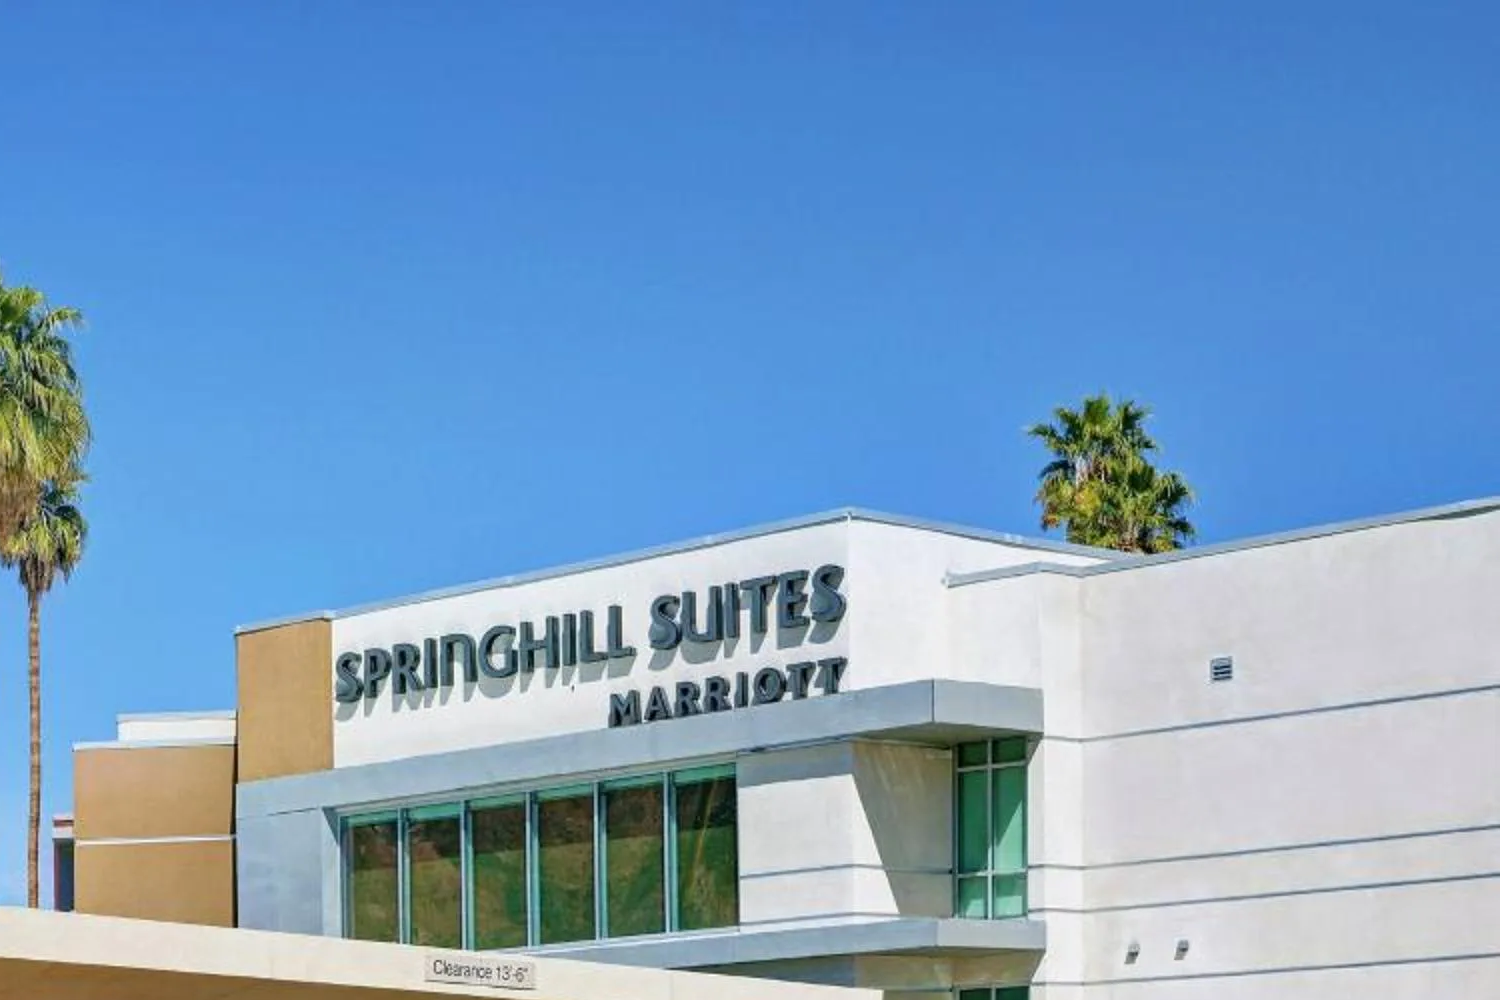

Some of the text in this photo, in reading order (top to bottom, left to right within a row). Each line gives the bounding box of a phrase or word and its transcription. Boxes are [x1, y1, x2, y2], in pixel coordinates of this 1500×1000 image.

[336, 564, 847, 703] SPRINGHILL SUITES
[608, 656, 847, 728] MARRIOTT
[433, 960, 492, 979] Clearance
